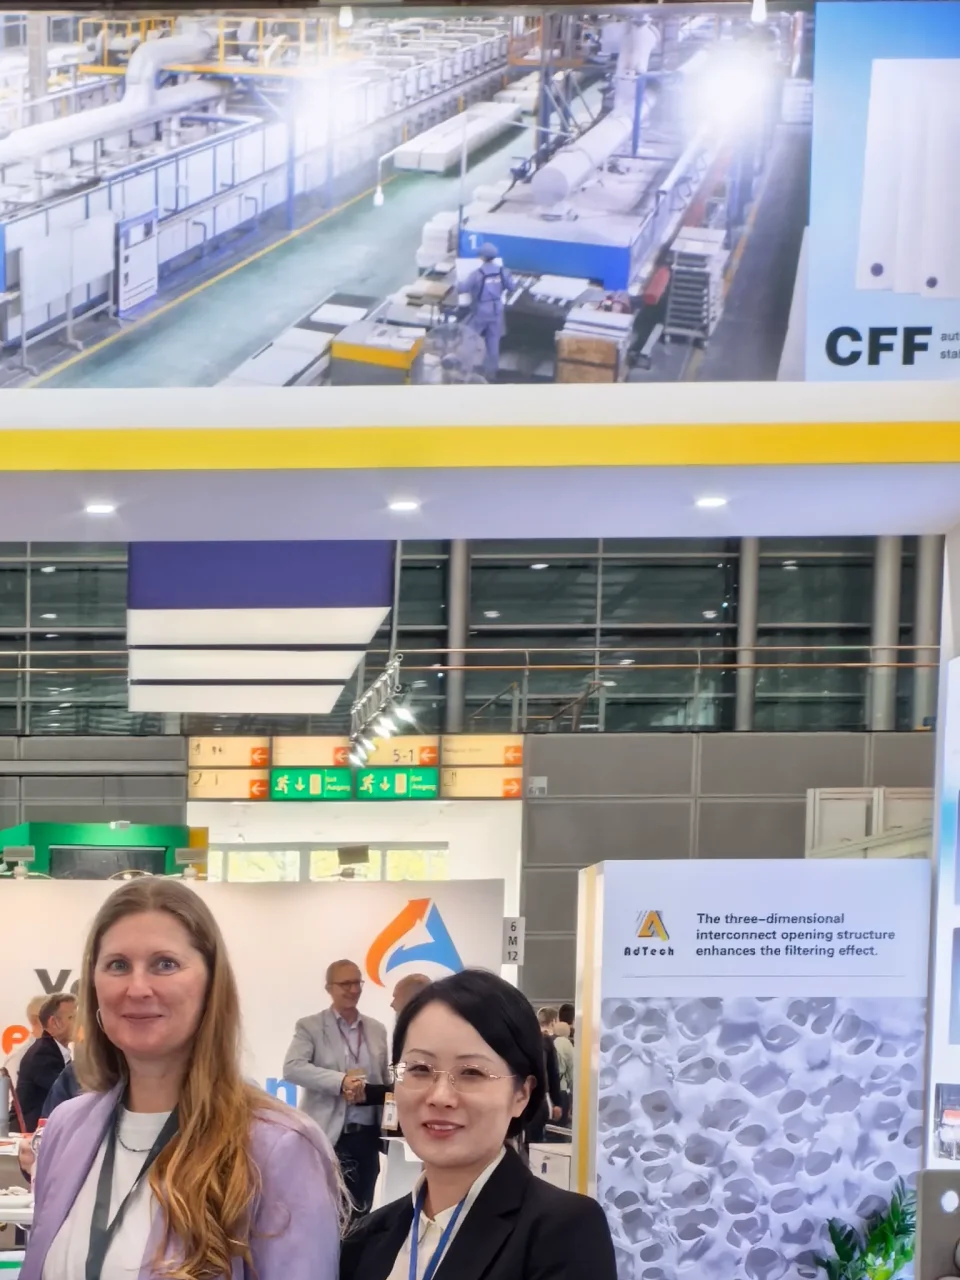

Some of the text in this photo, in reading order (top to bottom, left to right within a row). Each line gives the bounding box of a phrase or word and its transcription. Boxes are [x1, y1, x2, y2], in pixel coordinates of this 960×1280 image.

[825, 326, 933, 366] CFF
[393, 749, 415, 764] 5-1
[697, 913, 720, 924] The
[510, 921, 517, 932] 6
[508, 936, 518, 946] M
[696, 929, 895, 943] interconnect opening structure
[508, 951, 518, 961] 12
[696, 944, 878, 958] enhances the filtering effect.
